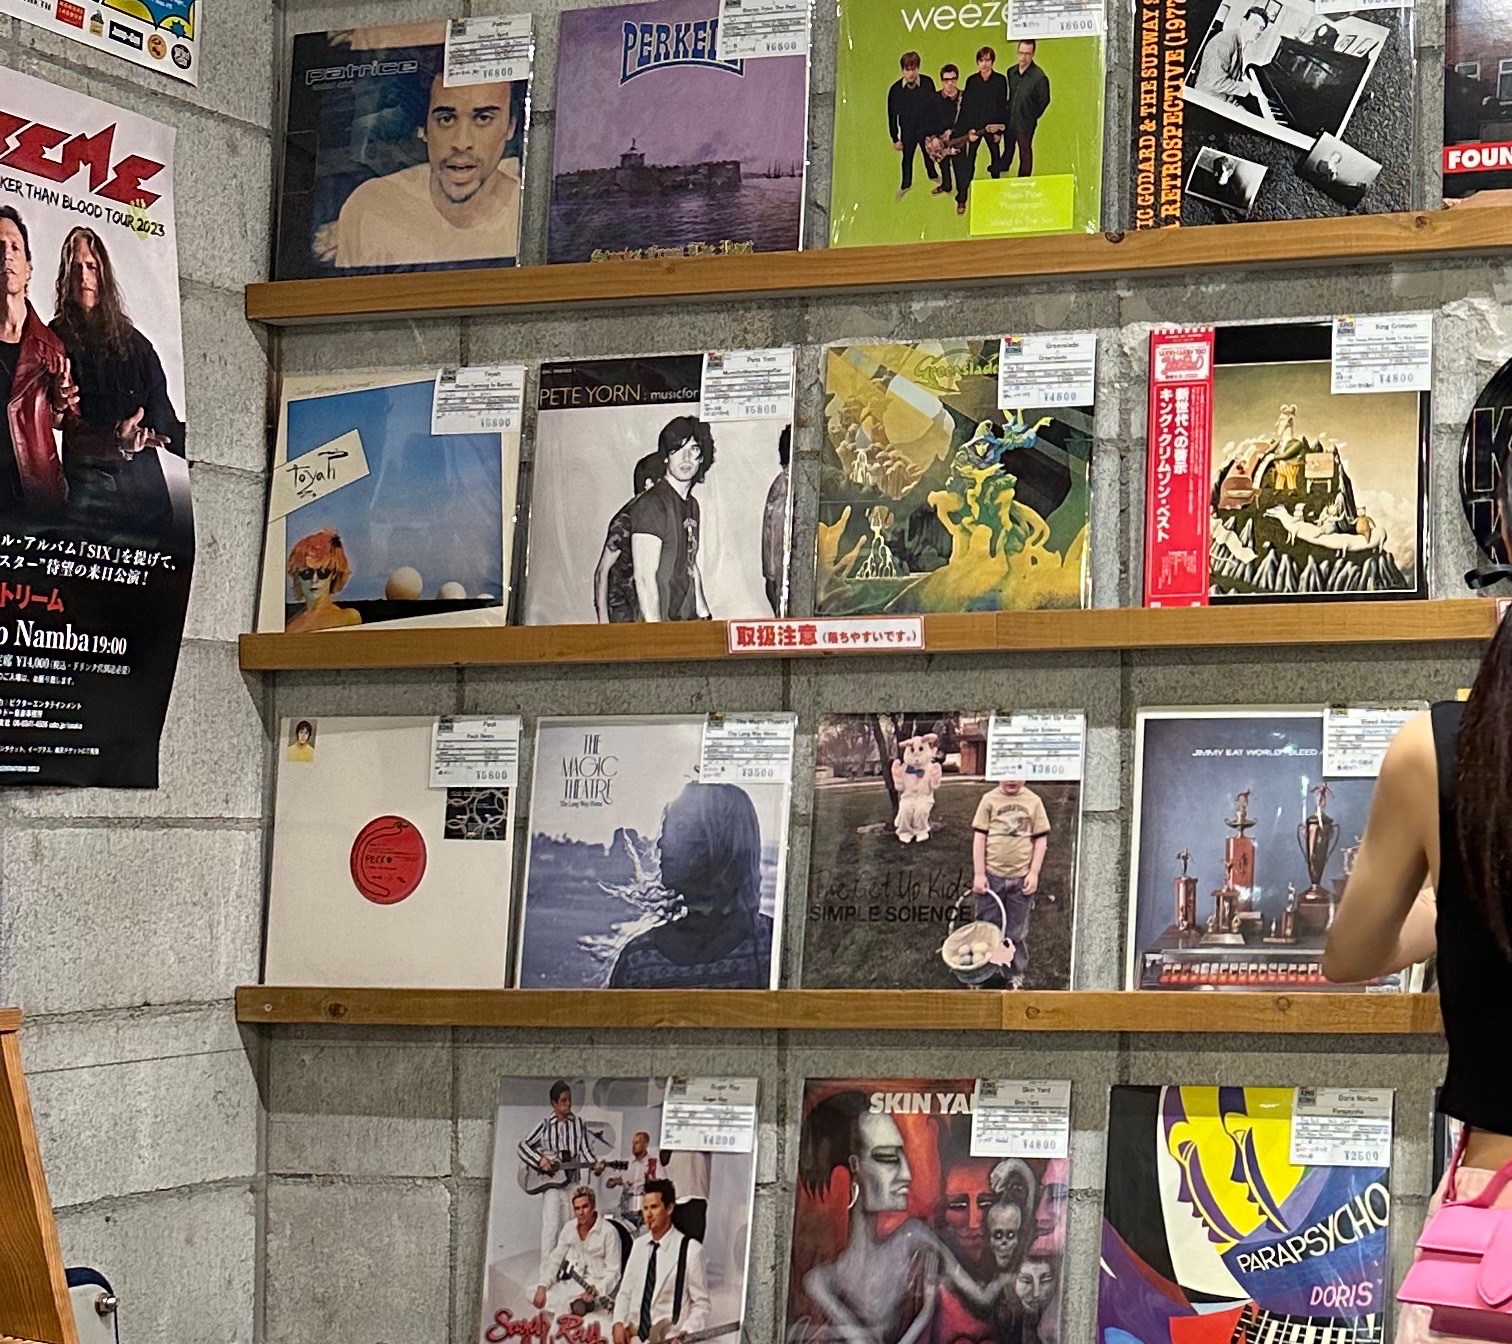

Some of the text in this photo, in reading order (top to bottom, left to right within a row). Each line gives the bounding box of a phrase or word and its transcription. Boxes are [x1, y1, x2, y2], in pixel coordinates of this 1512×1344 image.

[1141, 9, 1159, 77] SUBWAY
[305, 59, 419, 86] patrice
[1140, 80, 1158, 115] THE
[1161, 49, 1185, 219] RETROSPECTIVE
[0, 113, 166, 209] EME
[1136, 135, 1156, 209] GODARD
[25, 183, 60, 206] THAN
[62, 195, 103, 219] BLOOD
[105, 207, 135, 231] TOUR
[136, 217, 166, 237] 2023
[540, 386, 581, 407] PETE
[585, 384, 641, 404] YORN
[14, 619, 128, 655] Namba 19:00
[736, 623, 817, 647] 取扱注意
[582, 733, 602, 755] THE
[561, 755, 619, 778] MAGIC
[808, 904, 972, 924] SIMPLE SCIENCE
[869, 1092, 932, 1115] SKIN
[1236, 1182, 1390, 1273] PARAPSYCHO
[1310, 1281, 1373, 1308] DORIS
